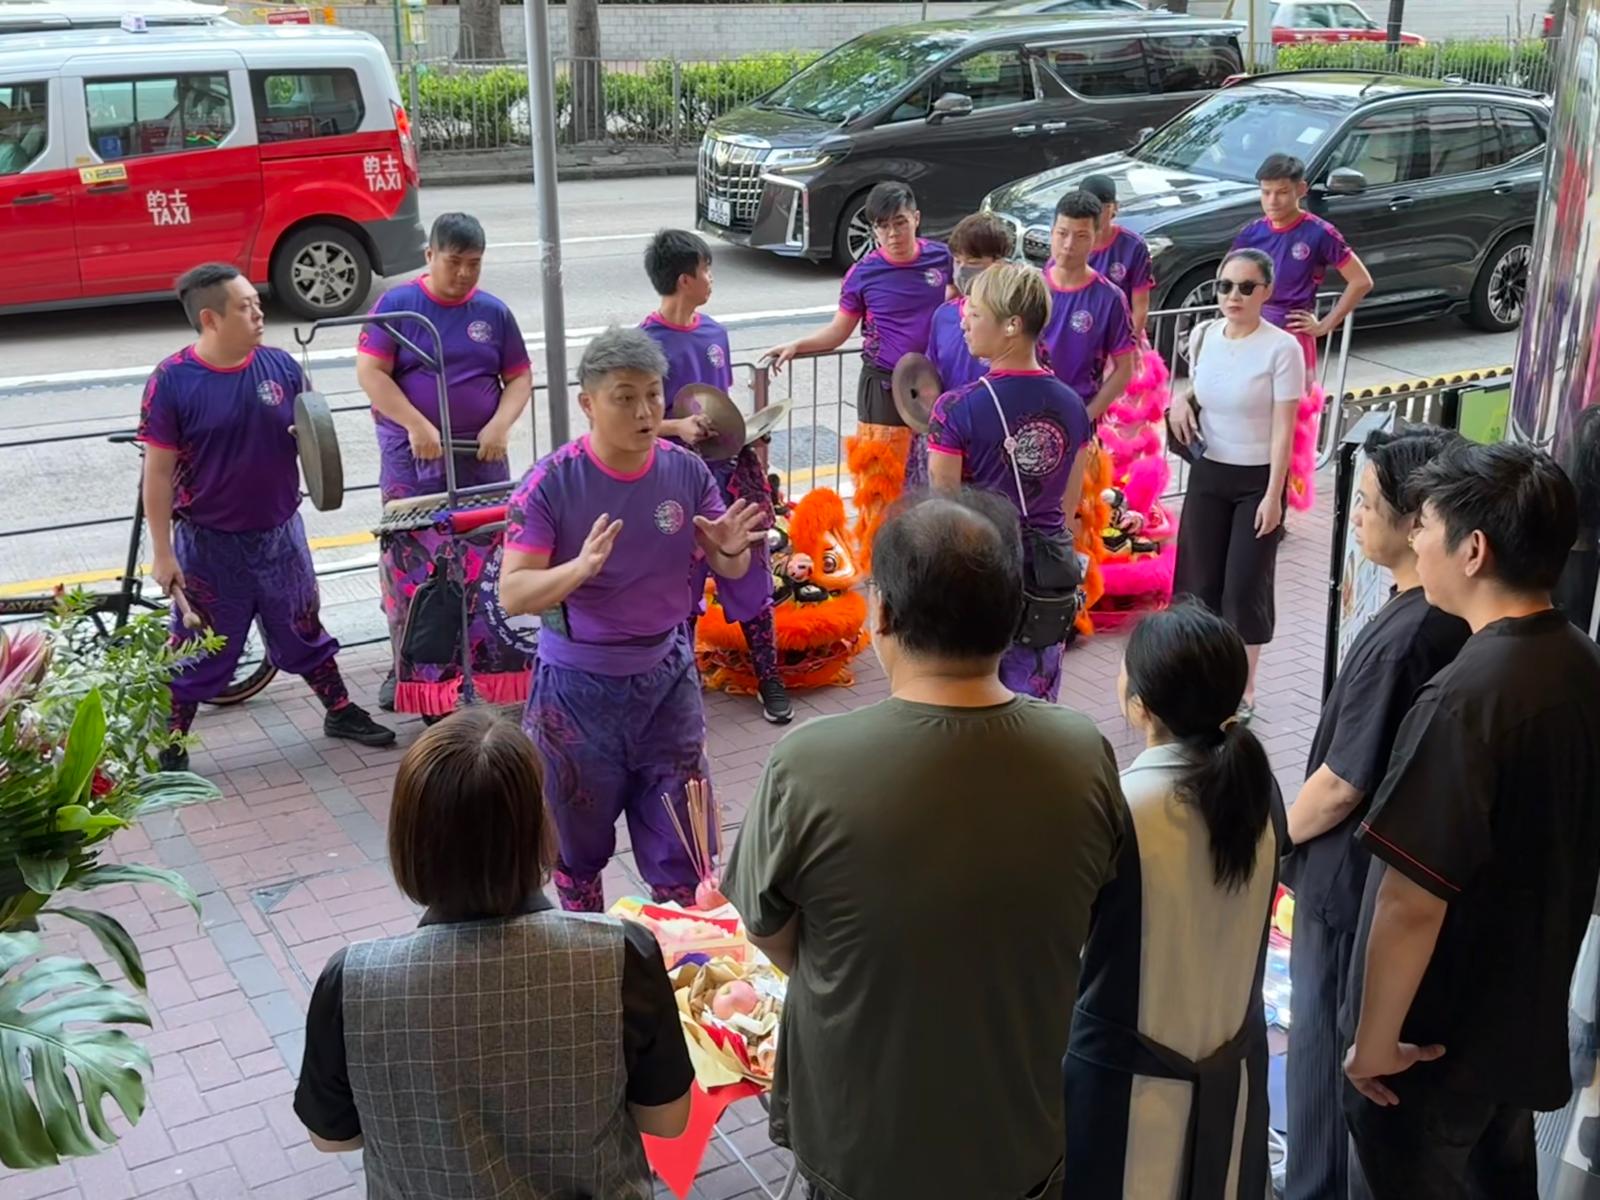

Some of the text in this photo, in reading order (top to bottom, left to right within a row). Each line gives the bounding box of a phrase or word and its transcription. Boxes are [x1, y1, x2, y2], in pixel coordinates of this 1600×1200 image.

[363, 154, 399, 173] 的士
[364, 172, 402, 192] TAXI
[146, 188, 188, 208] 的士
[148, 206, 191, 226] TAXI
